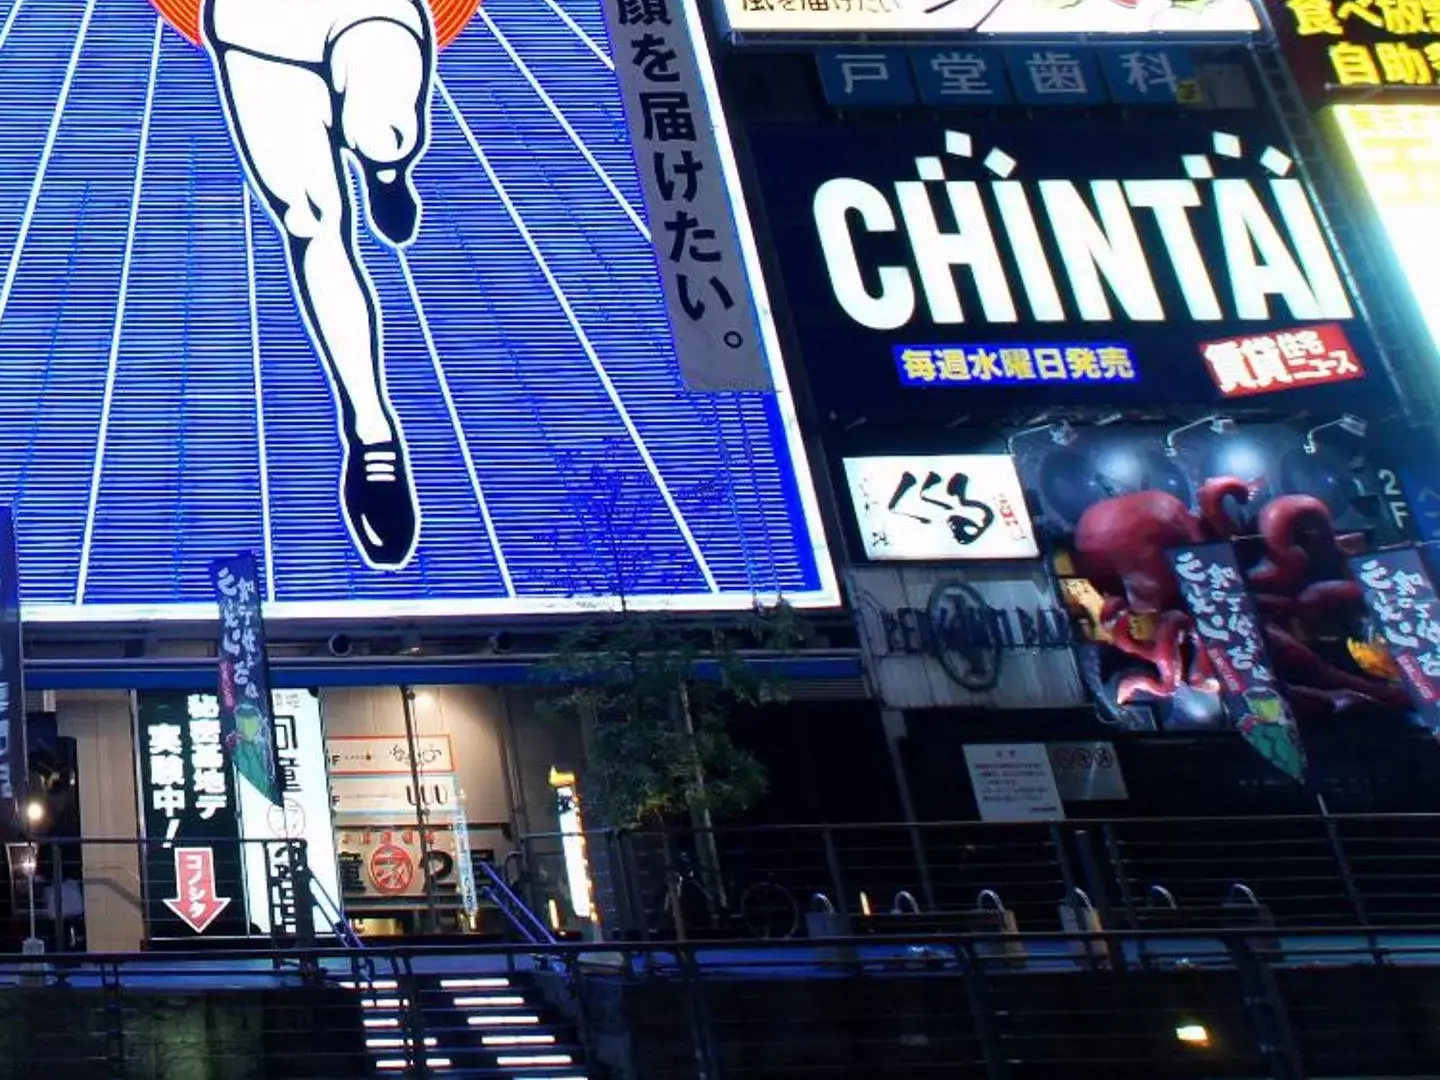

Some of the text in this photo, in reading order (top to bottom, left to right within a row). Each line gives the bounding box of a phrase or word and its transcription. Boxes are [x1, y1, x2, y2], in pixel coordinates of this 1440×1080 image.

[812, 130, 1356, 330] CHINTAI
[901, 346, 1137, 382] 毎週水曜日発売
